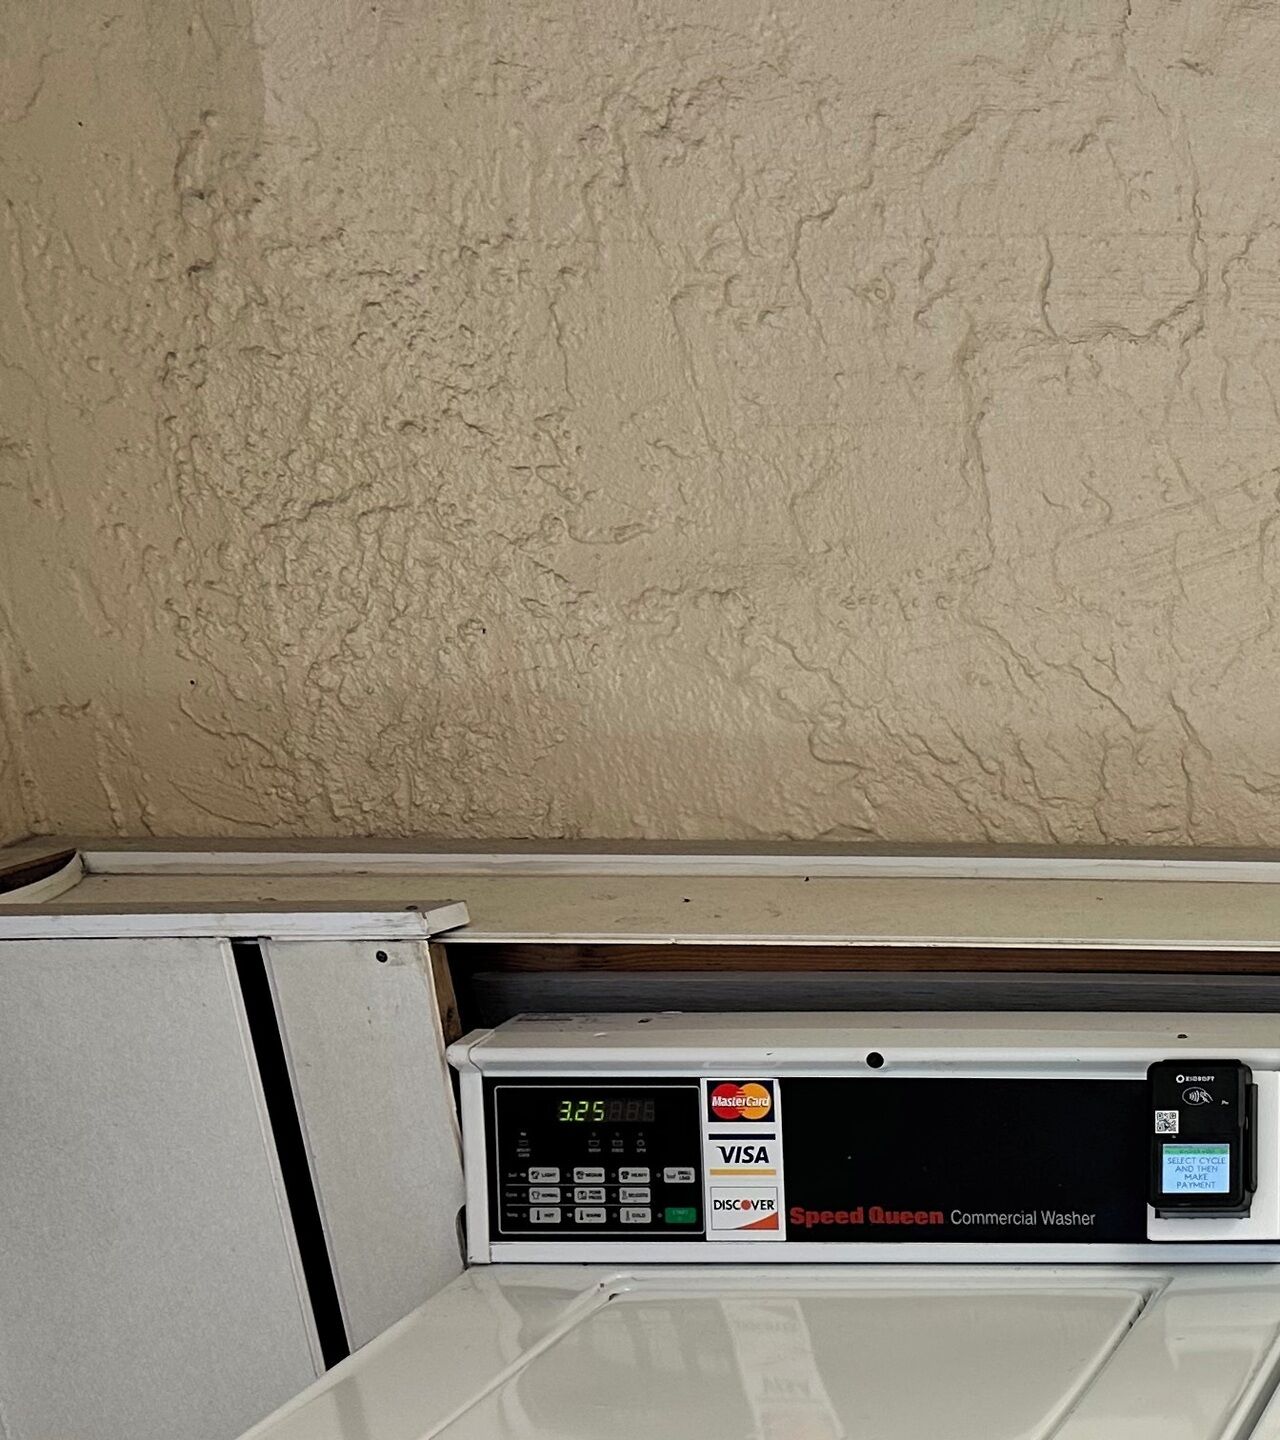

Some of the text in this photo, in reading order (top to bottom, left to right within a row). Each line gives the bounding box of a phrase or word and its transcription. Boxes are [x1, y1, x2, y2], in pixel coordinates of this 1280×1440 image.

[711, 1096, 771, 1108] MasterCard
[559, 1100, 606, 1121] 3.25
[716, 1146, 770, 1164] VISA
[1175, 1165, 1194, 1173] AND
[1176, 1181, 1216, 1189] PAYMENT
[713, 1199, 775, 1211] DISCOVER
[790, 1206, 1096, 1228] Speed Queen Commercial Washer
